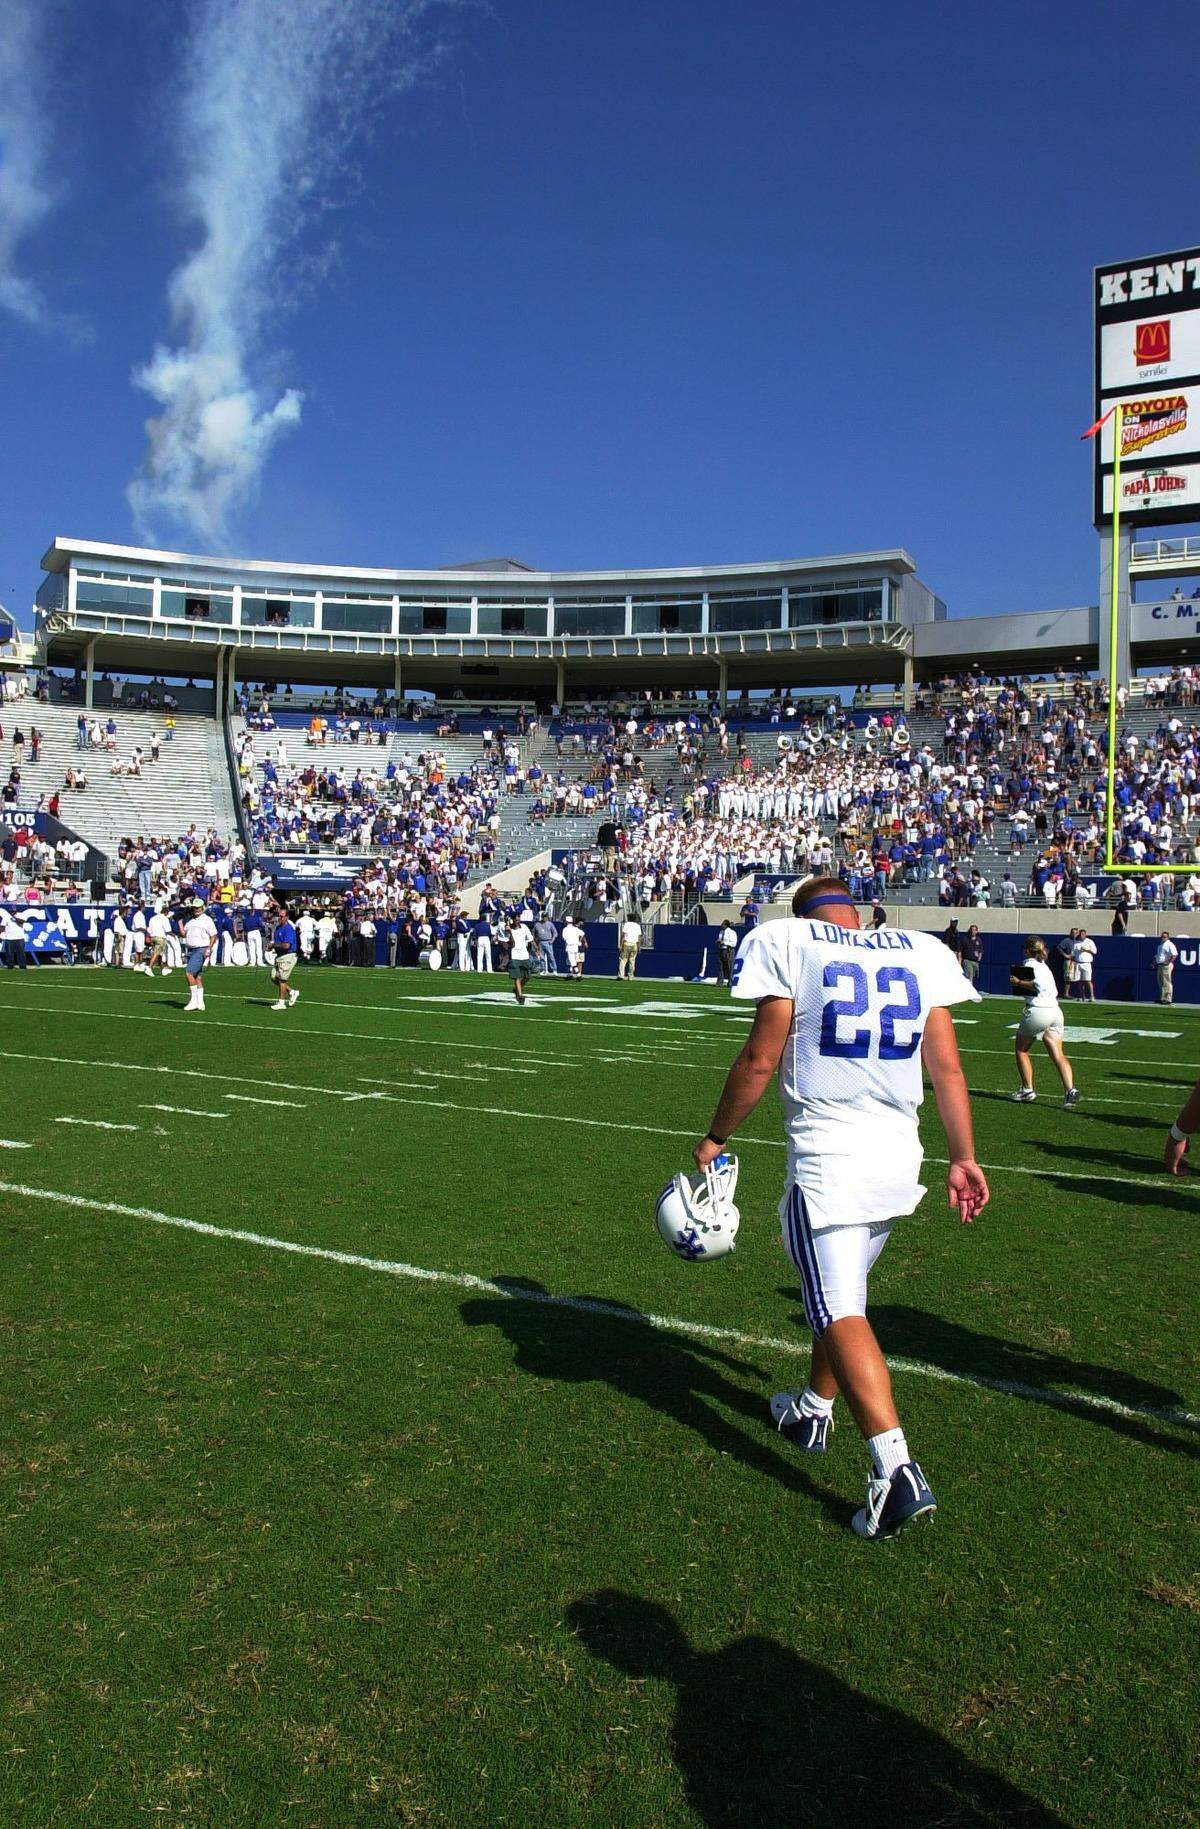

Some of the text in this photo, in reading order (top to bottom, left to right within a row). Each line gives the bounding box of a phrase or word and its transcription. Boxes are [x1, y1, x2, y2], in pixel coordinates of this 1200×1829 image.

[1121, 396, 1188, 416] TOYOTA
[1124, 415, 1141, 425] ON
[1125, 478, 1151, 495] PAPA
[1152, 604, 1199, 619] C. M.
[5, 812, 36, 826] 105
[819, 961, 922, 1060] 22
